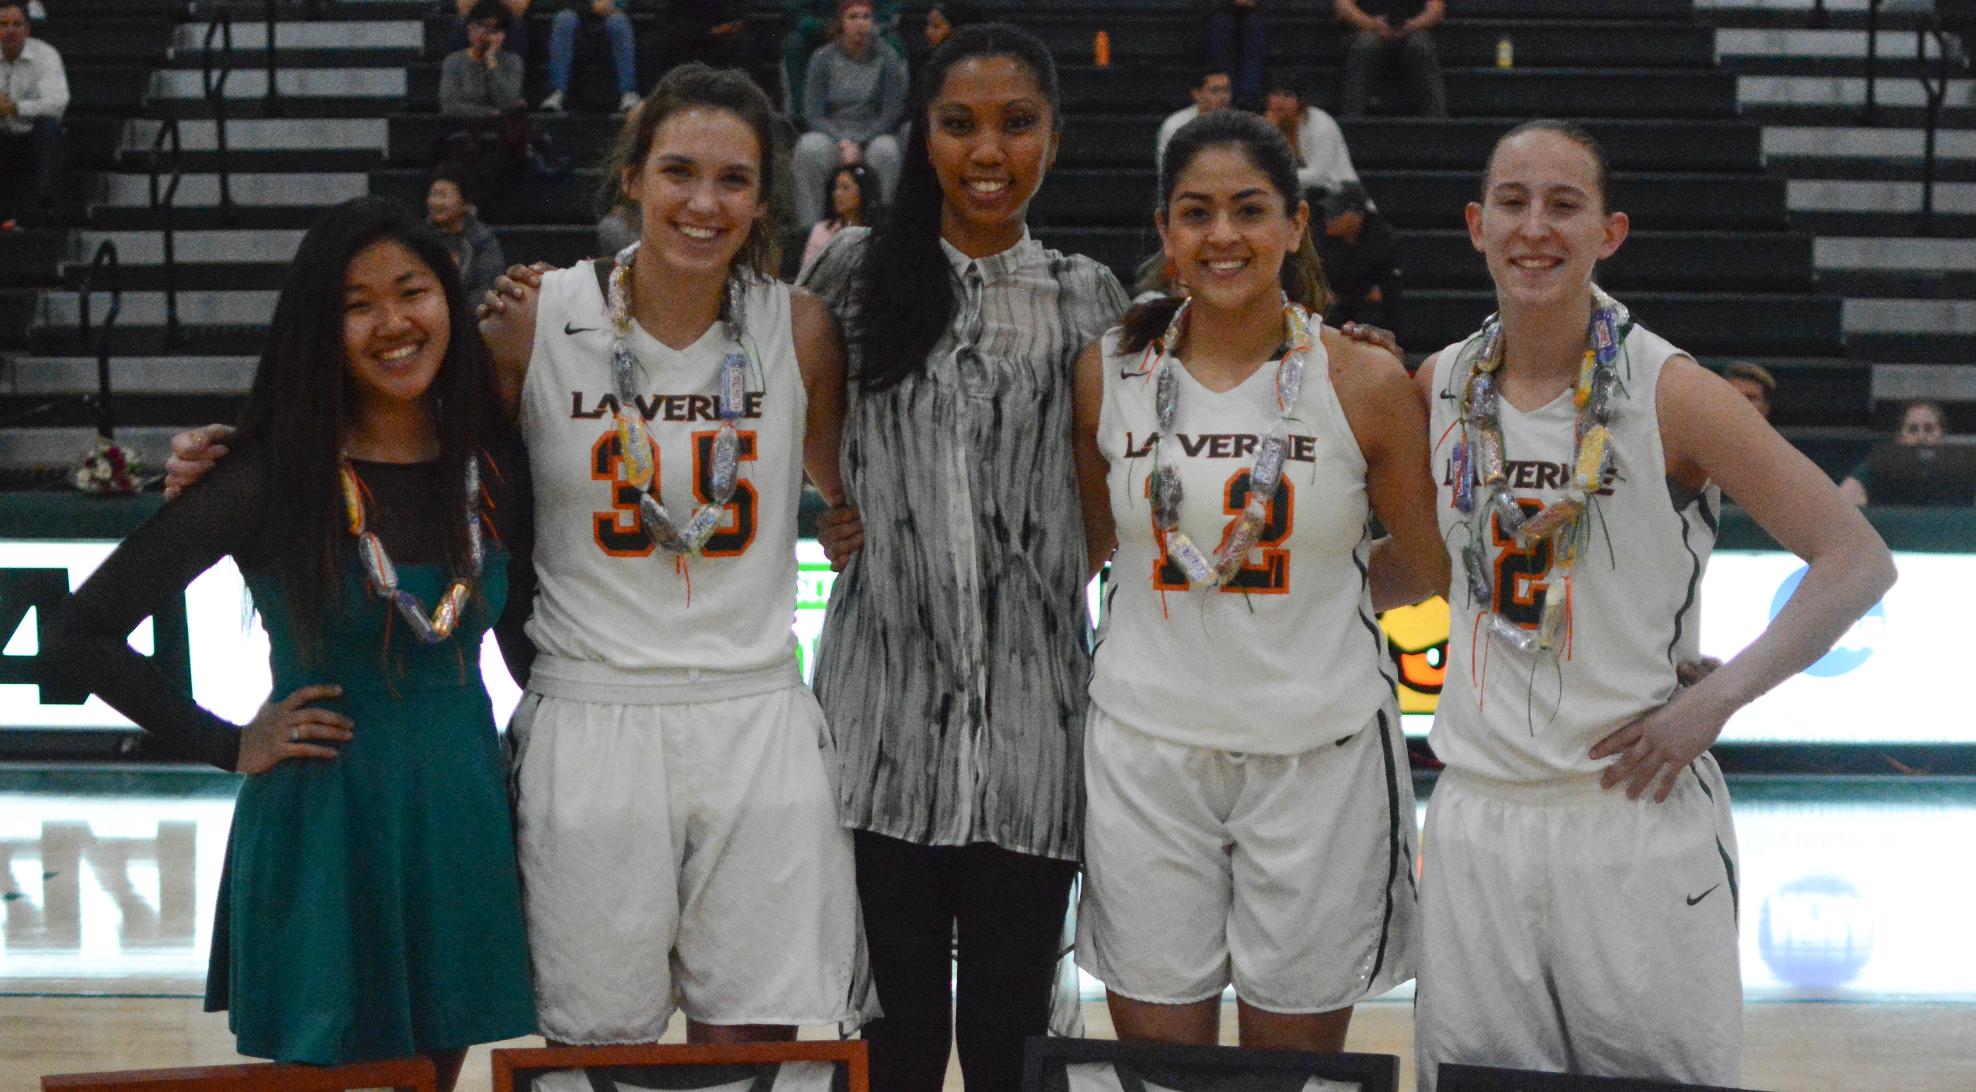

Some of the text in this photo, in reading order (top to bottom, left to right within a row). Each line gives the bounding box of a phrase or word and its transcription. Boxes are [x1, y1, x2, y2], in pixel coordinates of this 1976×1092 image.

[571, 391, 620, 419] LA
[591, 430, 759, 558] 35
[1503, 460, 1618, 496] VERE
